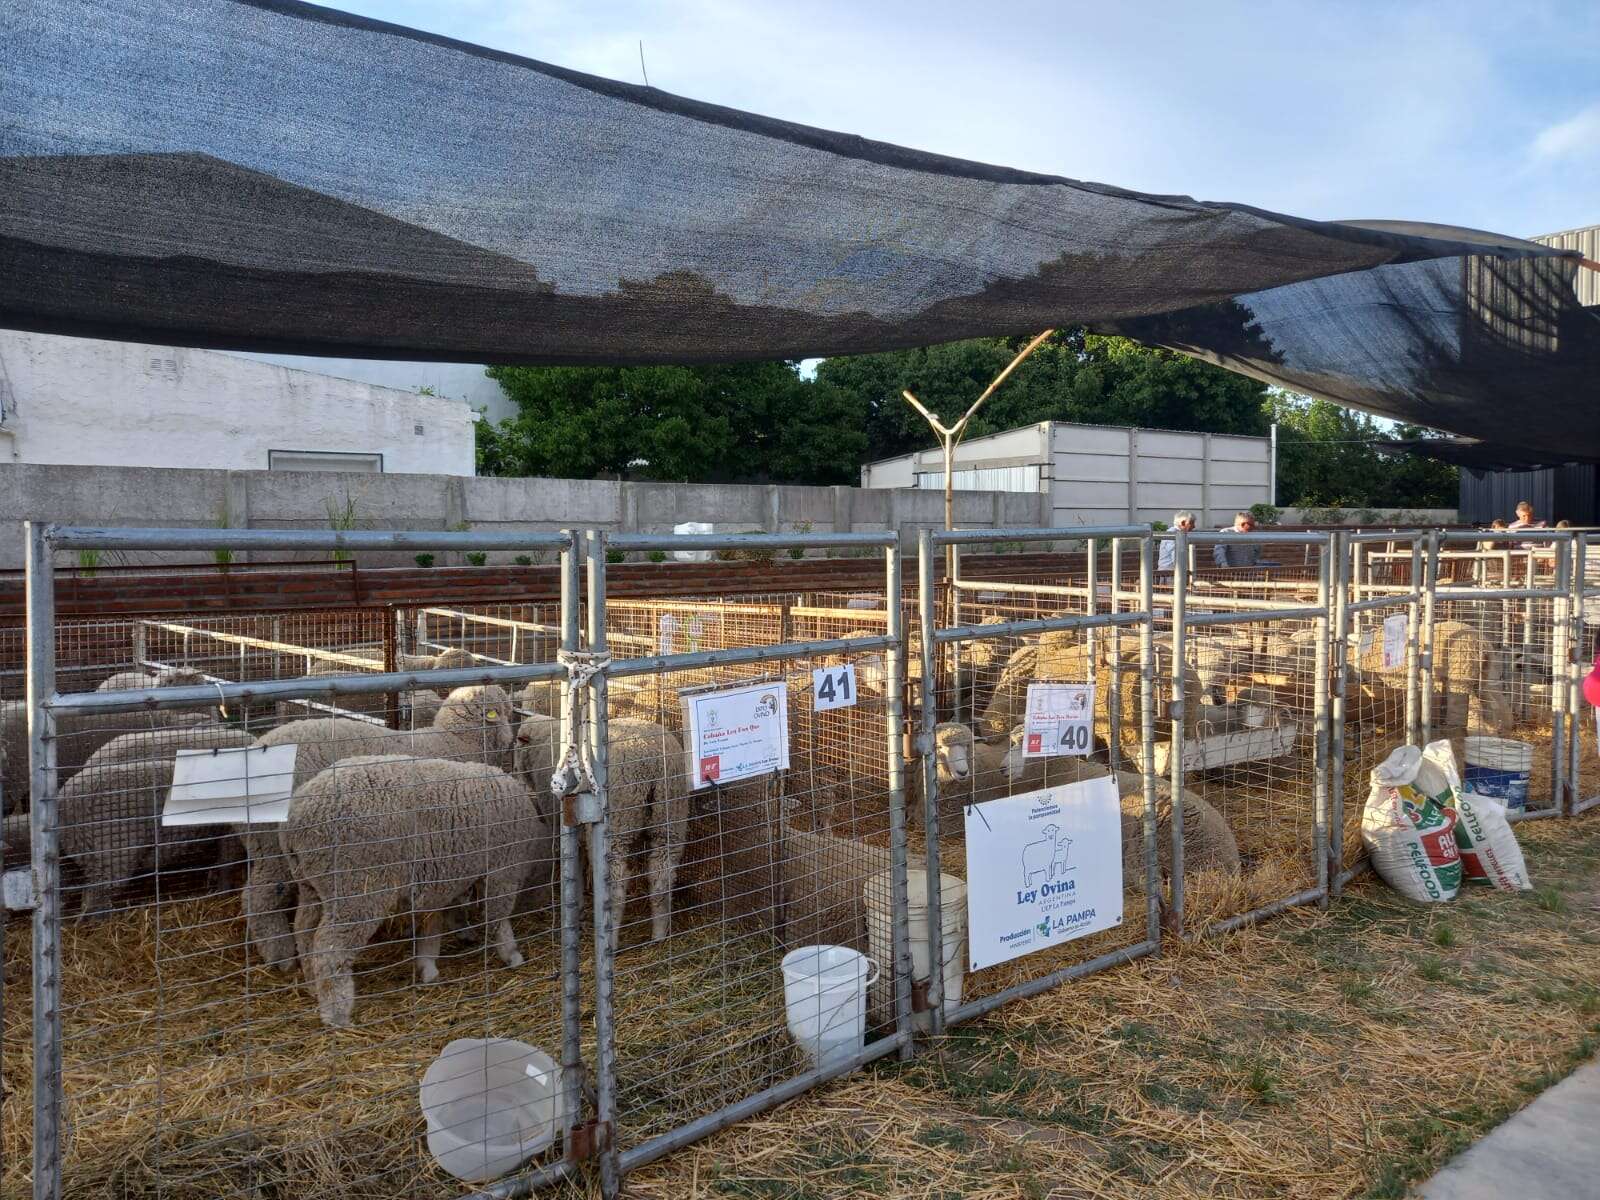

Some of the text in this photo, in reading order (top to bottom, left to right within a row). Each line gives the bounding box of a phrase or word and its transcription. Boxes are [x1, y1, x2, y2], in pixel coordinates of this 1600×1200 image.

[818, 672, 850, 702] 41
[1060, 725, 1089, 750] 40
[1017, 880, 1075, 905] Ley Ovina
[1052, 916, 1064, 930] LA
[1066, 908, 1096, 926] PAMPA
[1000, 928, 1032, 943] Producción
